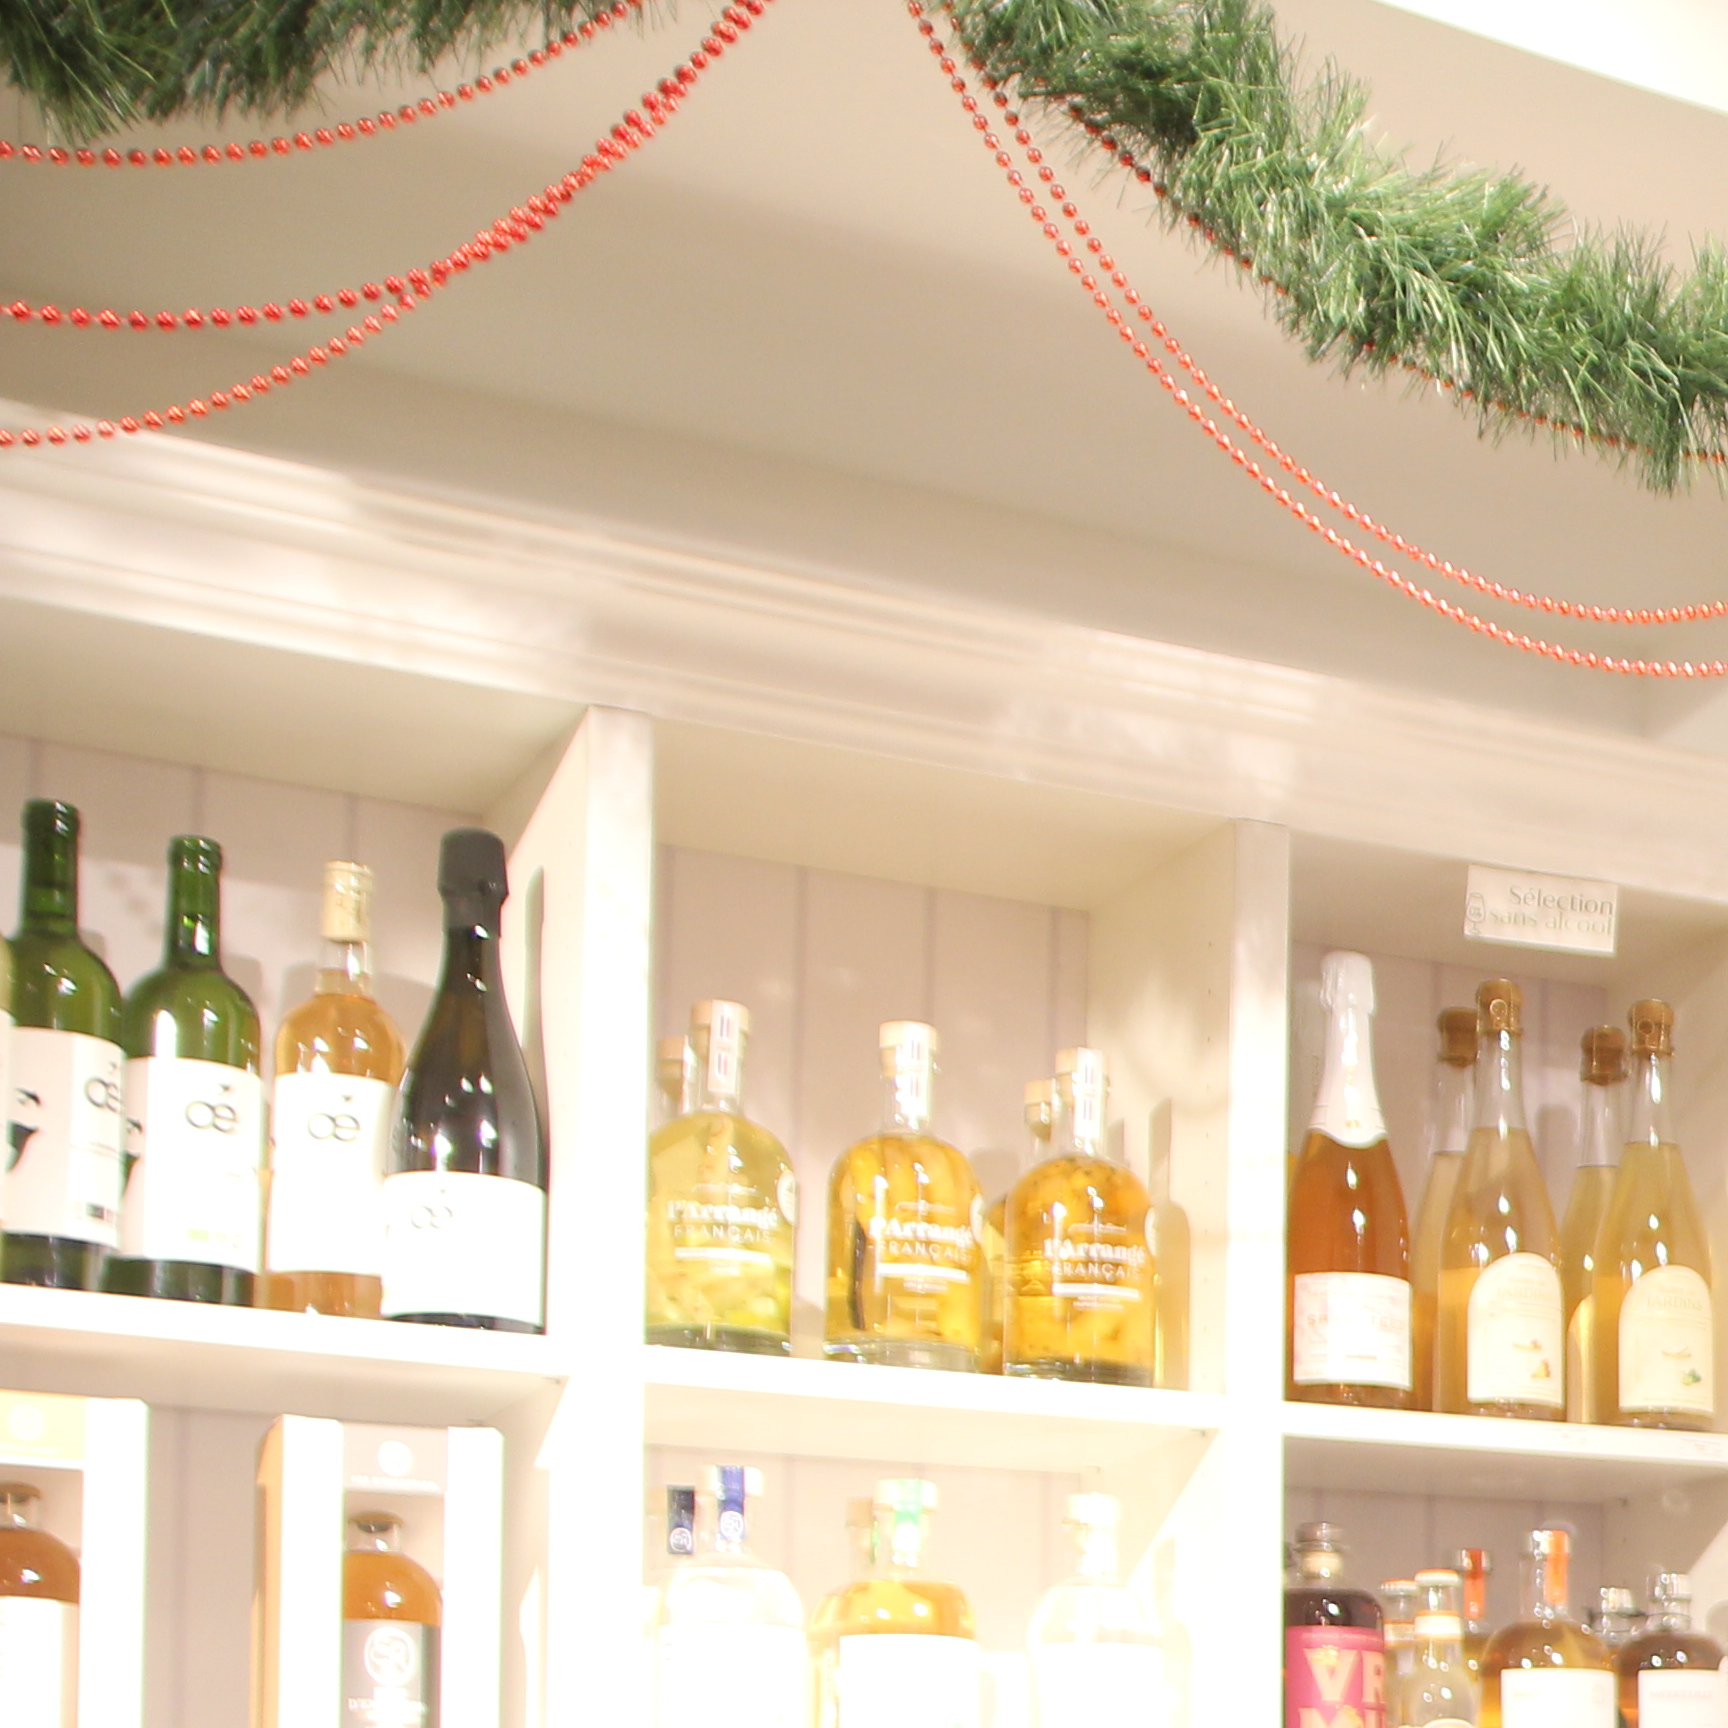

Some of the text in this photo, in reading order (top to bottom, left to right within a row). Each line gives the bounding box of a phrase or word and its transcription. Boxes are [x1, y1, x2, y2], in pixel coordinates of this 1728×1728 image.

[1508, 885, 1613, 915] Sélection
[1489, 908, 1538, 928] sans
[1545, 911, 1612, 936] alcool
[674, 1224, 774, 1246] FRANÇAIS
